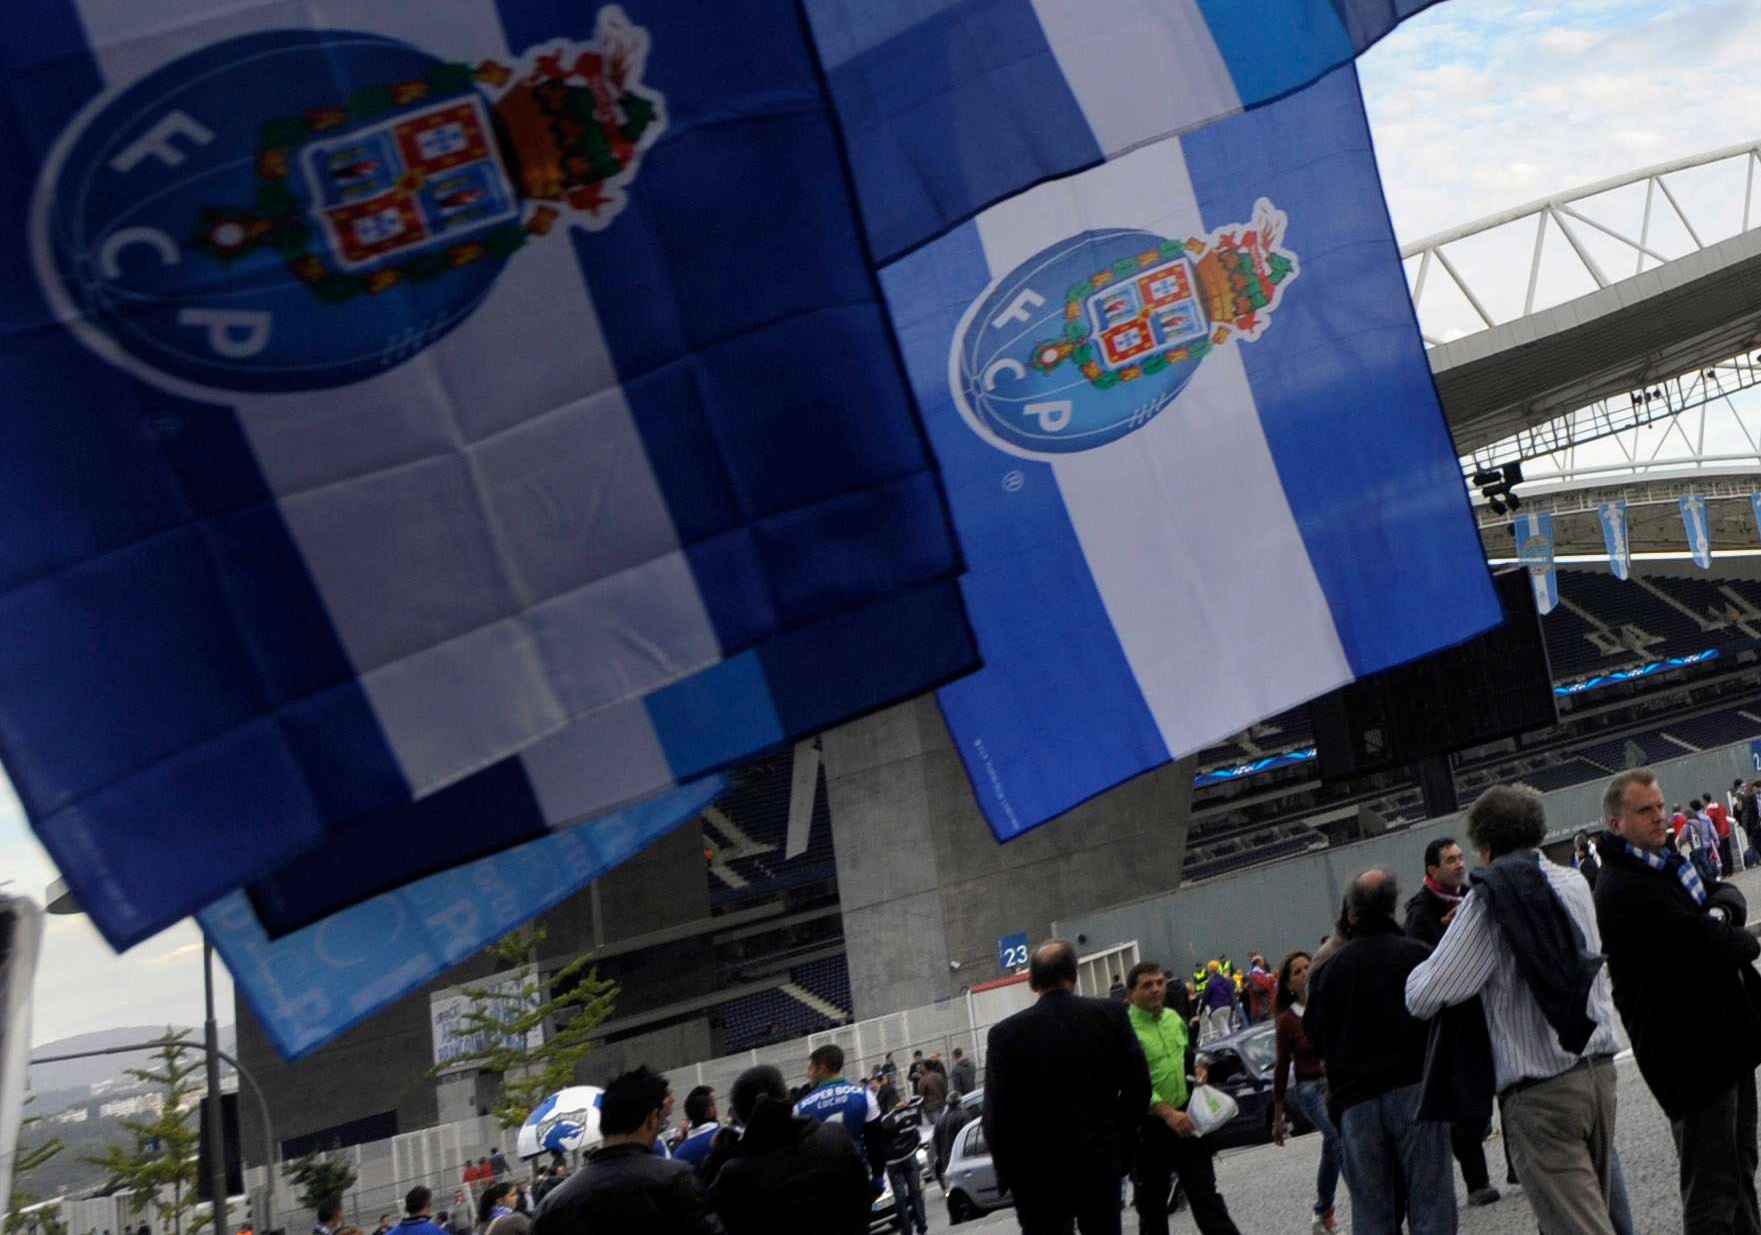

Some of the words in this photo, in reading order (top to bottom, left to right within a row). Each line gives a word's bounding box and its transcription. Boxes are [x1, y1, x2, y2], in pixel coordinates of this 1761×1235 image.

[1003, 944, 1029, 968] 23
[799, 1087, 835, 1110] SUPER
[835, 1084, 865, 1097] BOCK
[816, 1094, 849, 1111] LUCHO
